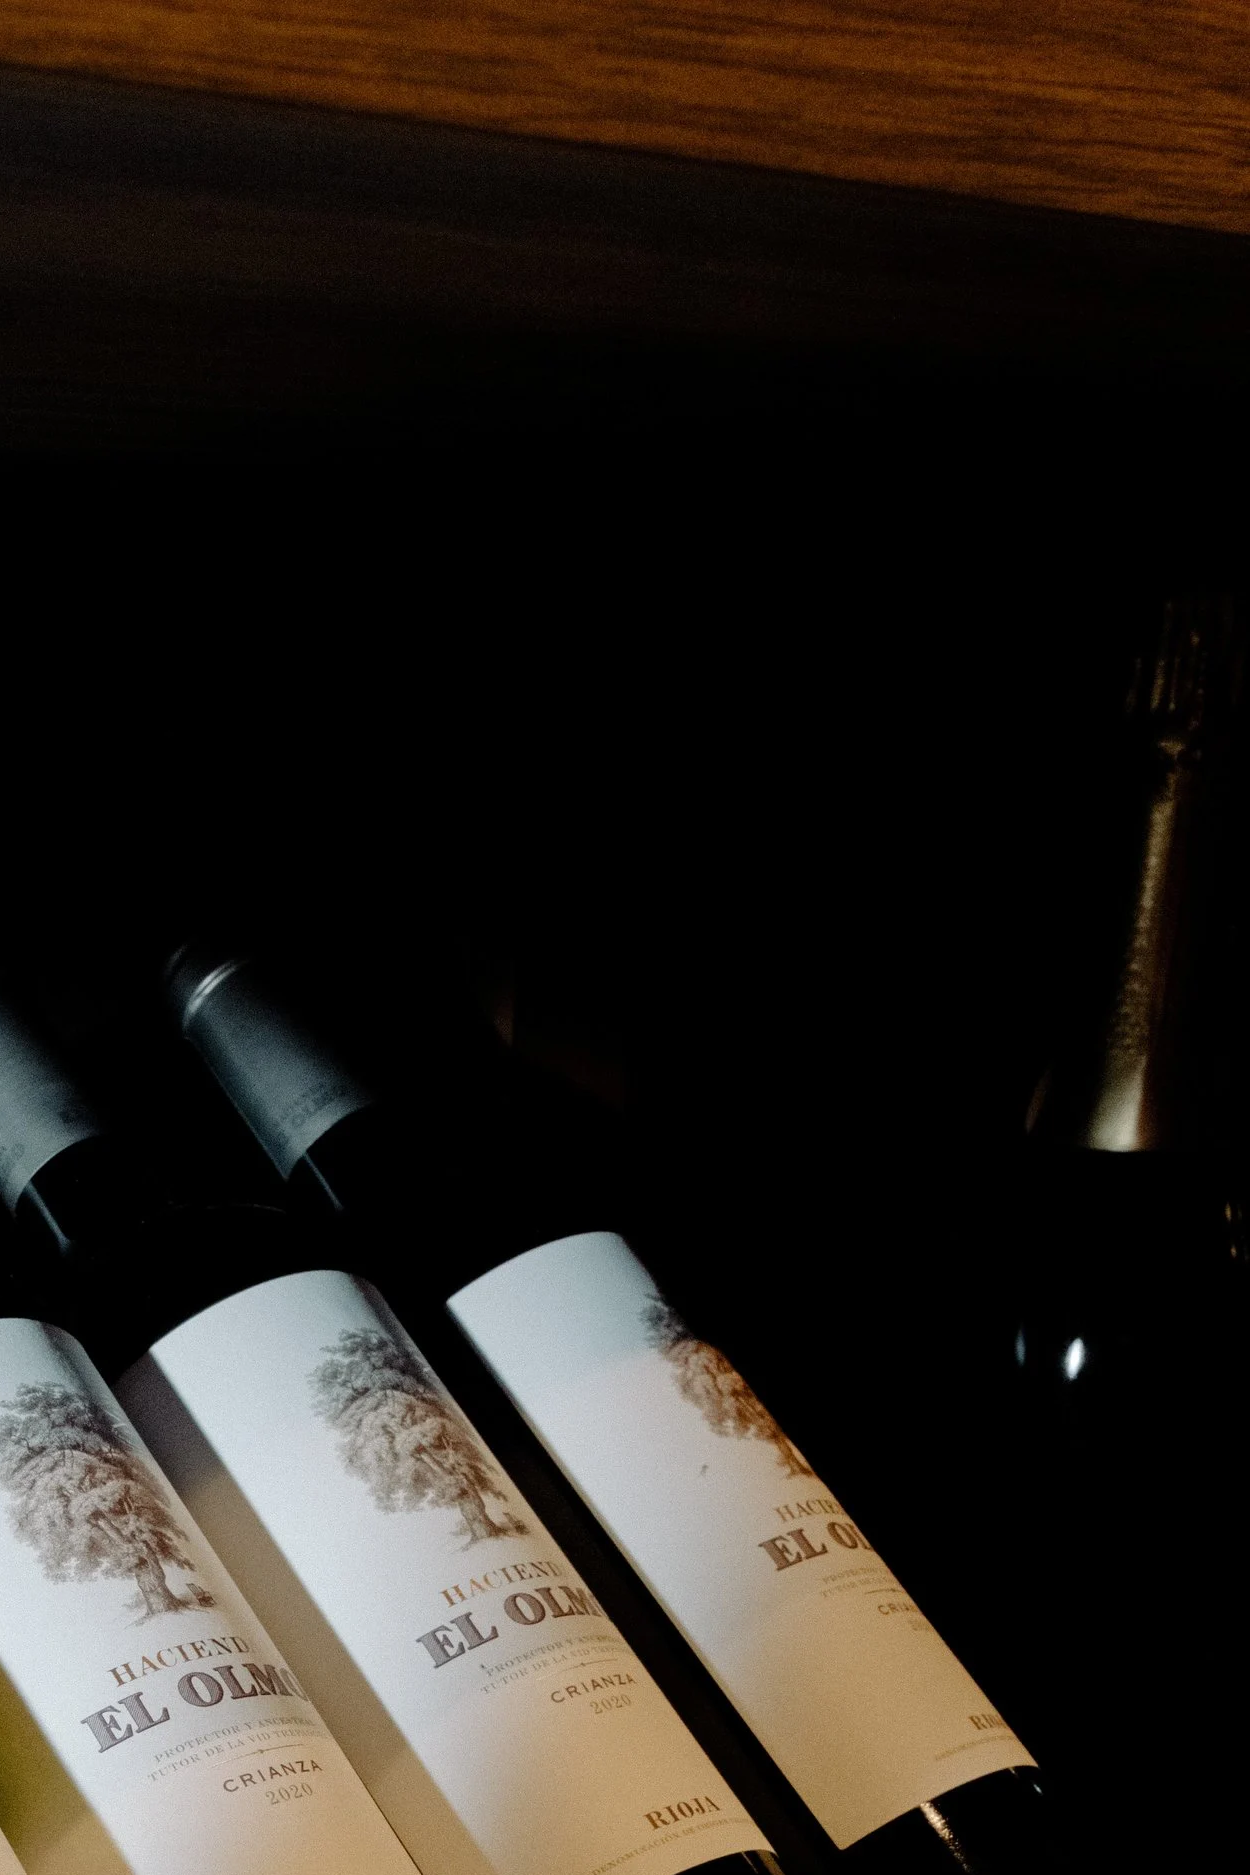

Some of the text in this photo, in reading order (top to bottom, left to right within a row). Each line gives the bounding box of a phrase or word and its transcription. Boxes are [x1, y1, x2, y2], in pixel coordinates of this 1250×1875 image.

[757, 1527, 829, 1572] EL
[440, 1560, 562, 1608] HACIEND
[415, 1610, 500, 1670] EL
[106, 1635, 252, 1688] HACIEND
[550, 1672, 637, 1704] CRIANZA
[589, 1693, 632, 1715] 2020
[80, 1690, 172, 1754] EL
[147, 1752, 203, 1784] TUTOR
[204, 1745, 225, 1759] DE
[227, 1736, 247, 1752] LA
[248, 1731, 273, 1746] VID
[153, 1724, 242, 1764] PROTECTOR
[222, 1758, 324, 1794] CRIANZA
[264, 1781, 315, 1806] 2020
[642, 1795, 721, 1832] RIOJA
